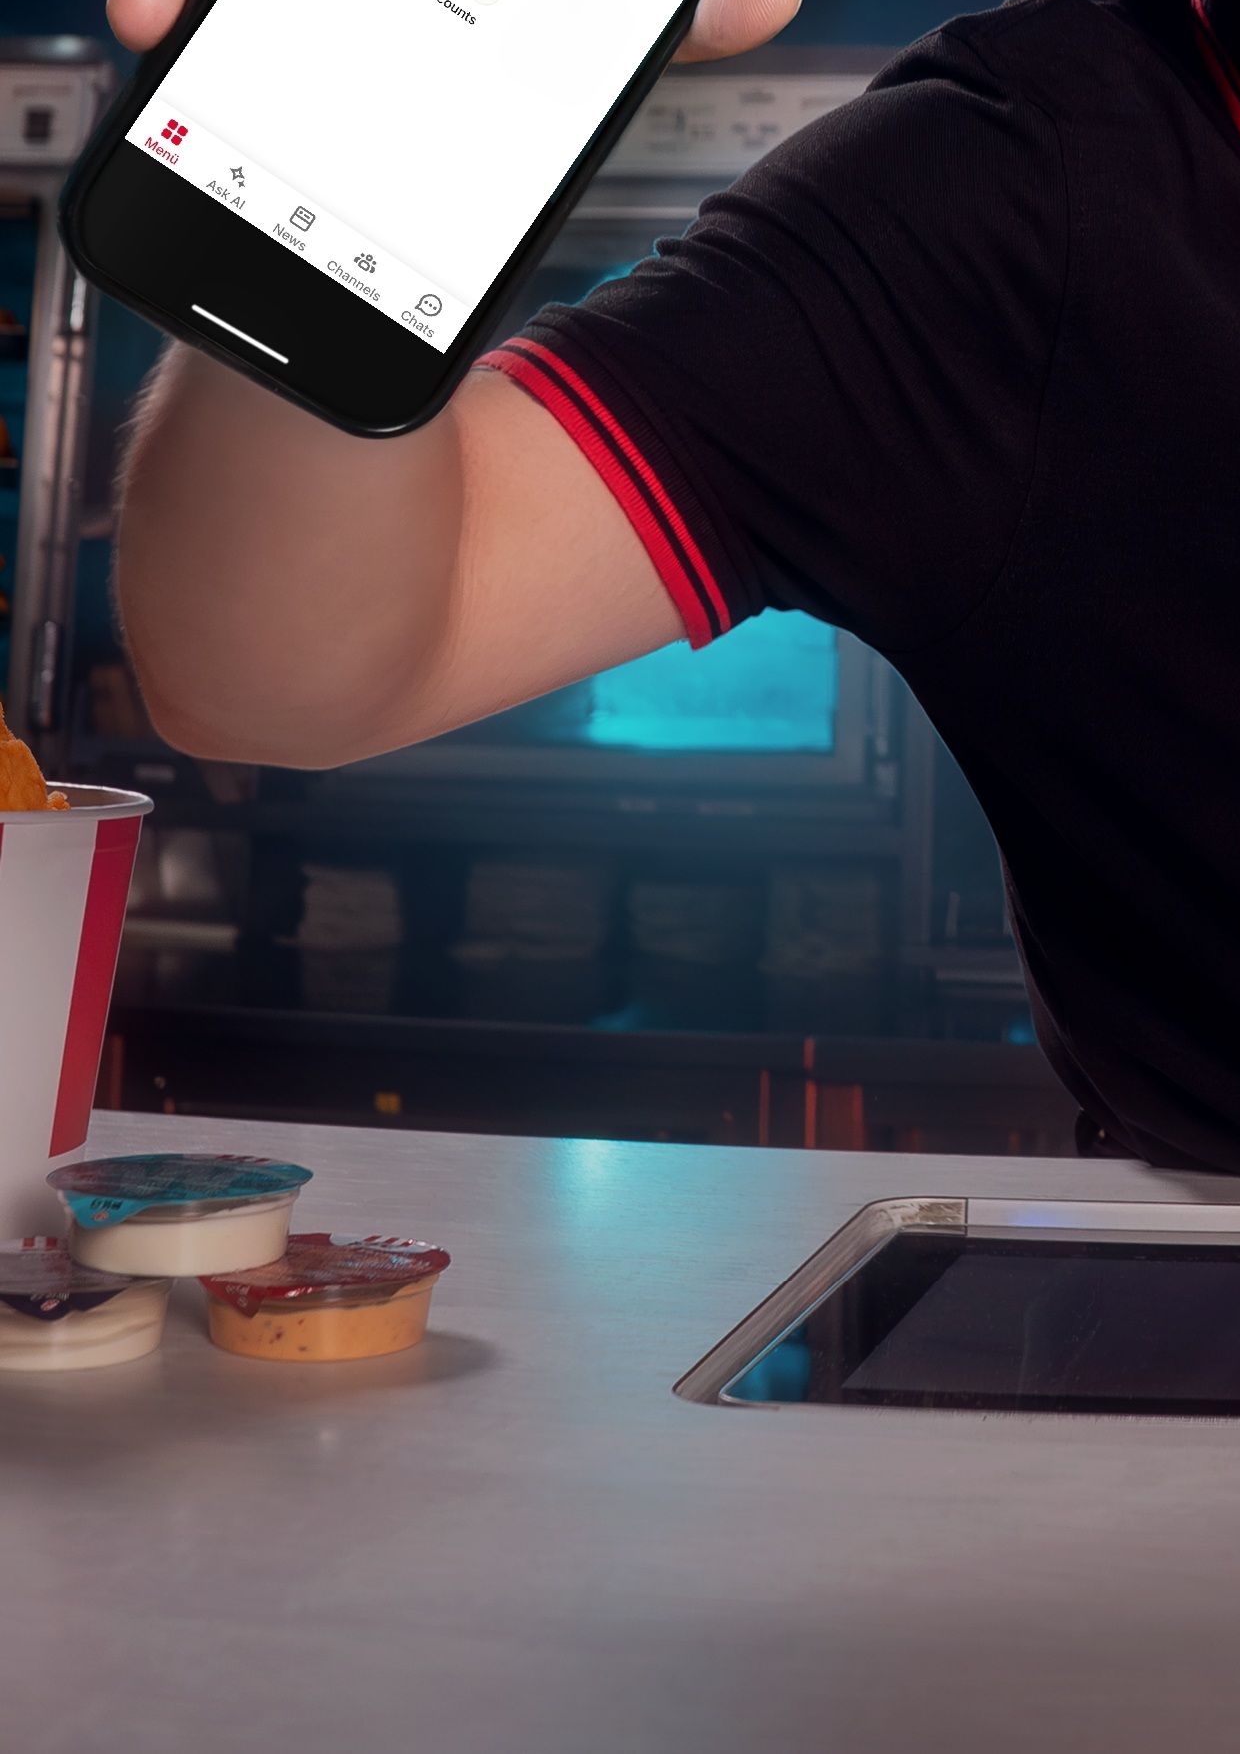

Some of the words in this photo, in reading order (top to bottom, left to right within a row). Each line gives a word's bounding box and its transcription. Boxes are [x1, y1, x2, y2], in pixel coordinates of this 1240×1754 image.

[144, 136, 180, 166] Menü
[205, 179, 231, 202] Ask
[230, 193, 246, 210] AI
[272, 222, 307, 252] News
[326, 259, 382, 303] Channels
[400, 309, 436, 339] Chats
